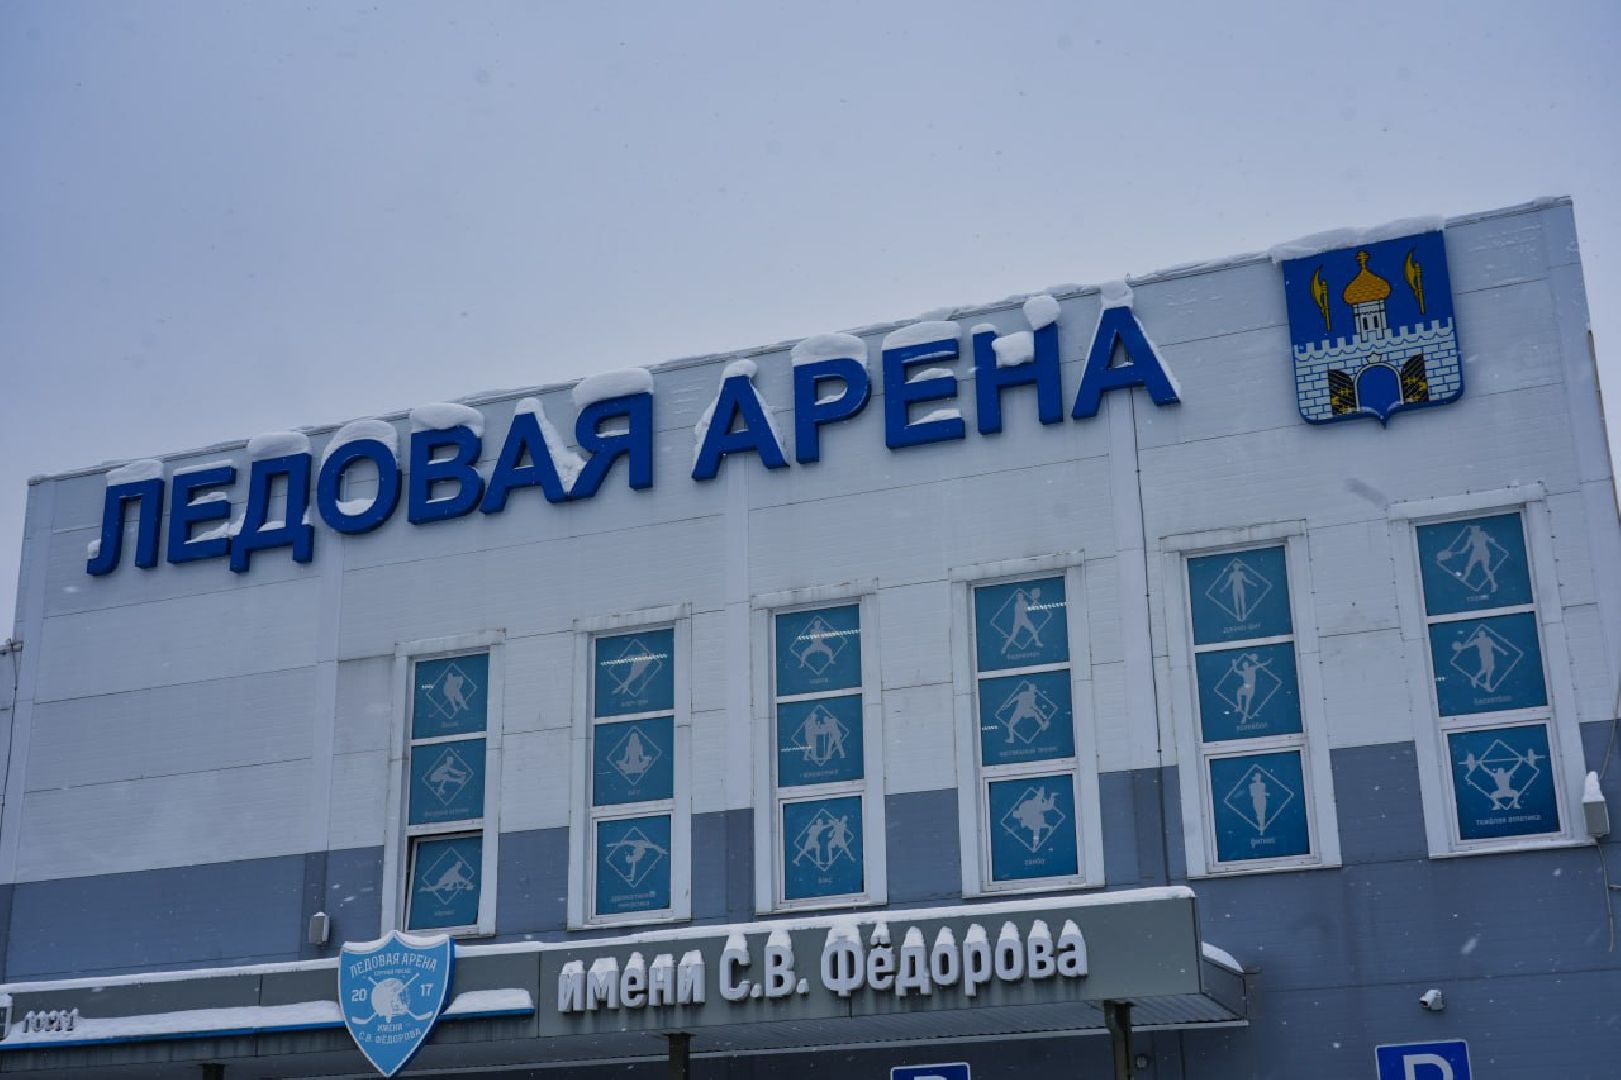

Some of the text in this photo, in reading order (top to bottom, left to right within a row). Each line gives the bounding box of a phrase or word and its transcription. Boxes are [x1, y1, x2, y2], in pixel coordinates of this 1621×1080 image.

[86, 304, 1182, 576] ЛЕДОВАЯ АРЕНА
[349, 953, 400, 978] ЛЕДОВАЯ
[401, 952, 438, 973] АРЕНА
[558, 931, 1089, 1012] имени С.В. Фёдорова
[352, 983, 434, 1002] 20 17
